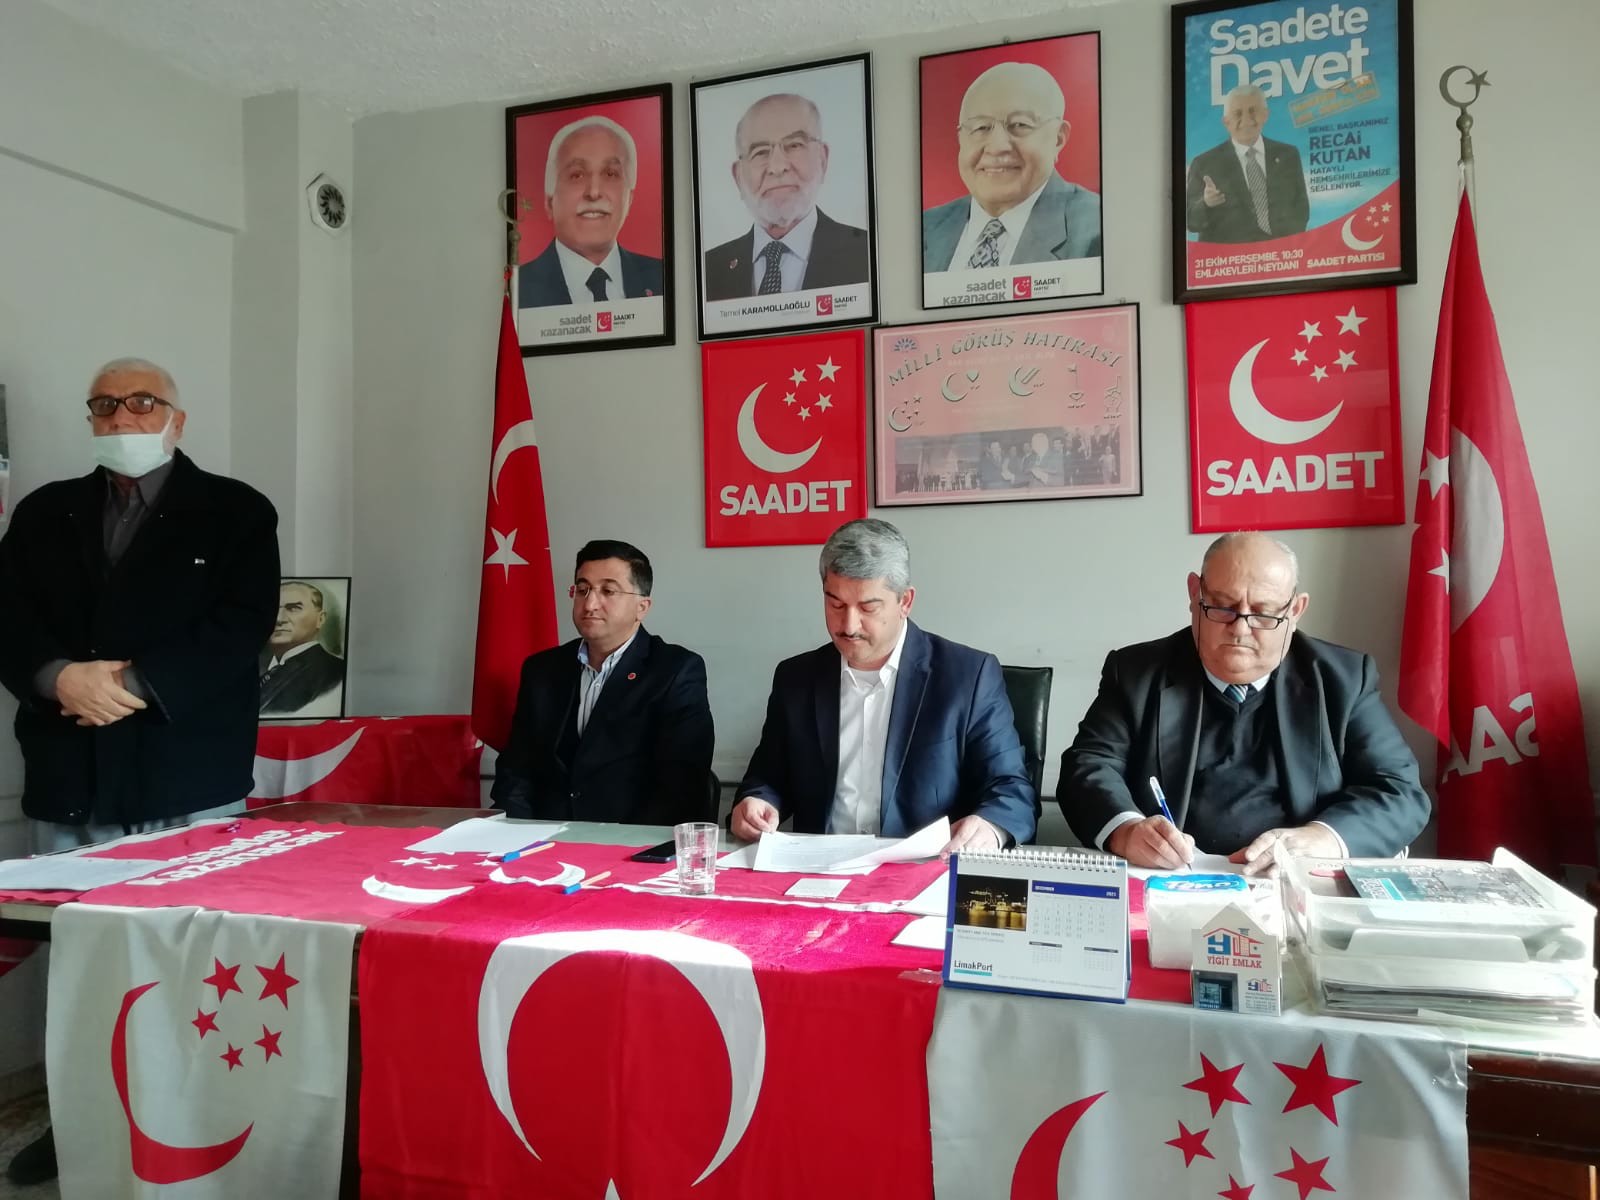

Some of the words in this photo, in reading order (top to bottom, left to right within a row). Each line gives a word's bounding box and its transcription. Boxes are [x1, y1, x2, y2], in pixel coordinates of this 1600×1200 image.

[1210, 3, 1369, 55] Saadete
[1210, 37, 1370, 106] Davet
[1310, 145, 1371, 165] KUTAN
[1195, 259, 1204, 269] 31
[1205, 255, 1228, 267] EKİM
[1195, 262, 1257, 279] EMLAKEVLERİ
[1258, 260, 1299, 273] MEYDANI
[1307, 256, 1345, 268] SAADET
[966, 278, 1007, 293] saadet
[1033, 277, 1061, 287] SAADET
[943, 291, 1006, 307] kazanacak
[742, 300, 810, 316] KARAMOLLAOĞLU
[560, 314, 592, 326] saadet
[540, 325, 592, 337] kazanacak
[1206, 451, 1385, 496] SAADET
[720, 480, 852, 516] SAADET
[954, 960, 993, 972] LimakPort
[1232, 958, 1263, 969] EMLAK
